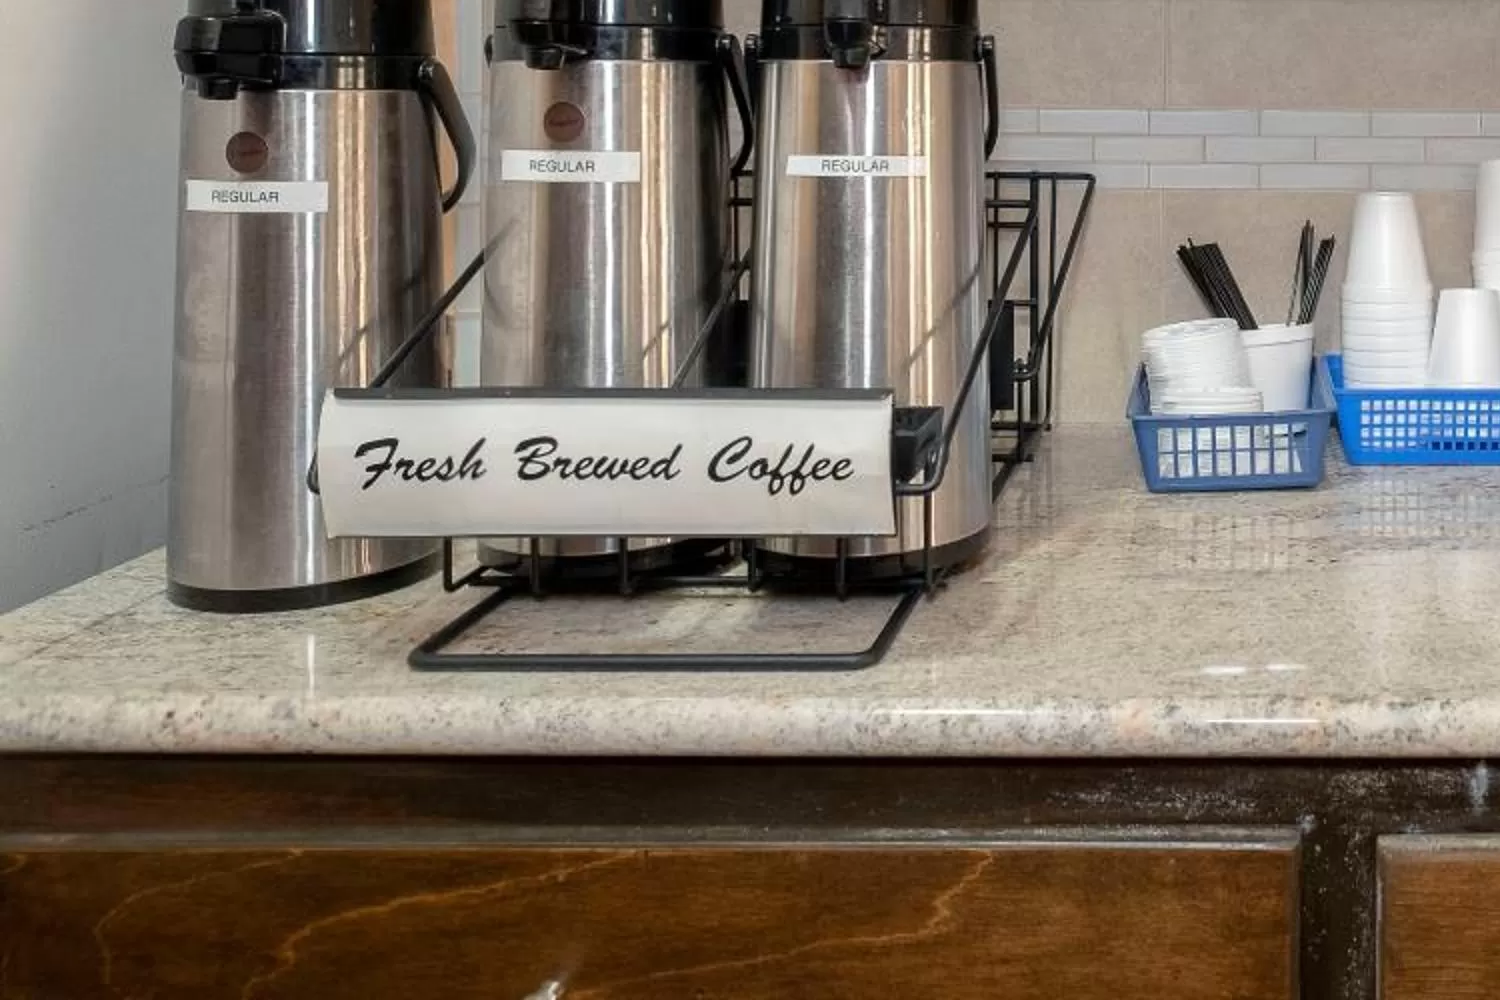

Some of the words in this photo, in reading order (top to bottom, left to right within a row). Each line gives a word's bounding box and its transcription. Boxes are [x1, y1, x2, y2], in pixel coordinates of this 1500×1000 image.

[529, 159, 596, 173] REGULAR
[821, 159, 889, 173] REGULAR
[211, 189, 279, 204] REGULAR
[354, 436, 488, 490] Fresh
[513, 435, 684, 482] Brewed
[707, 435, 854, 496] Coffee
